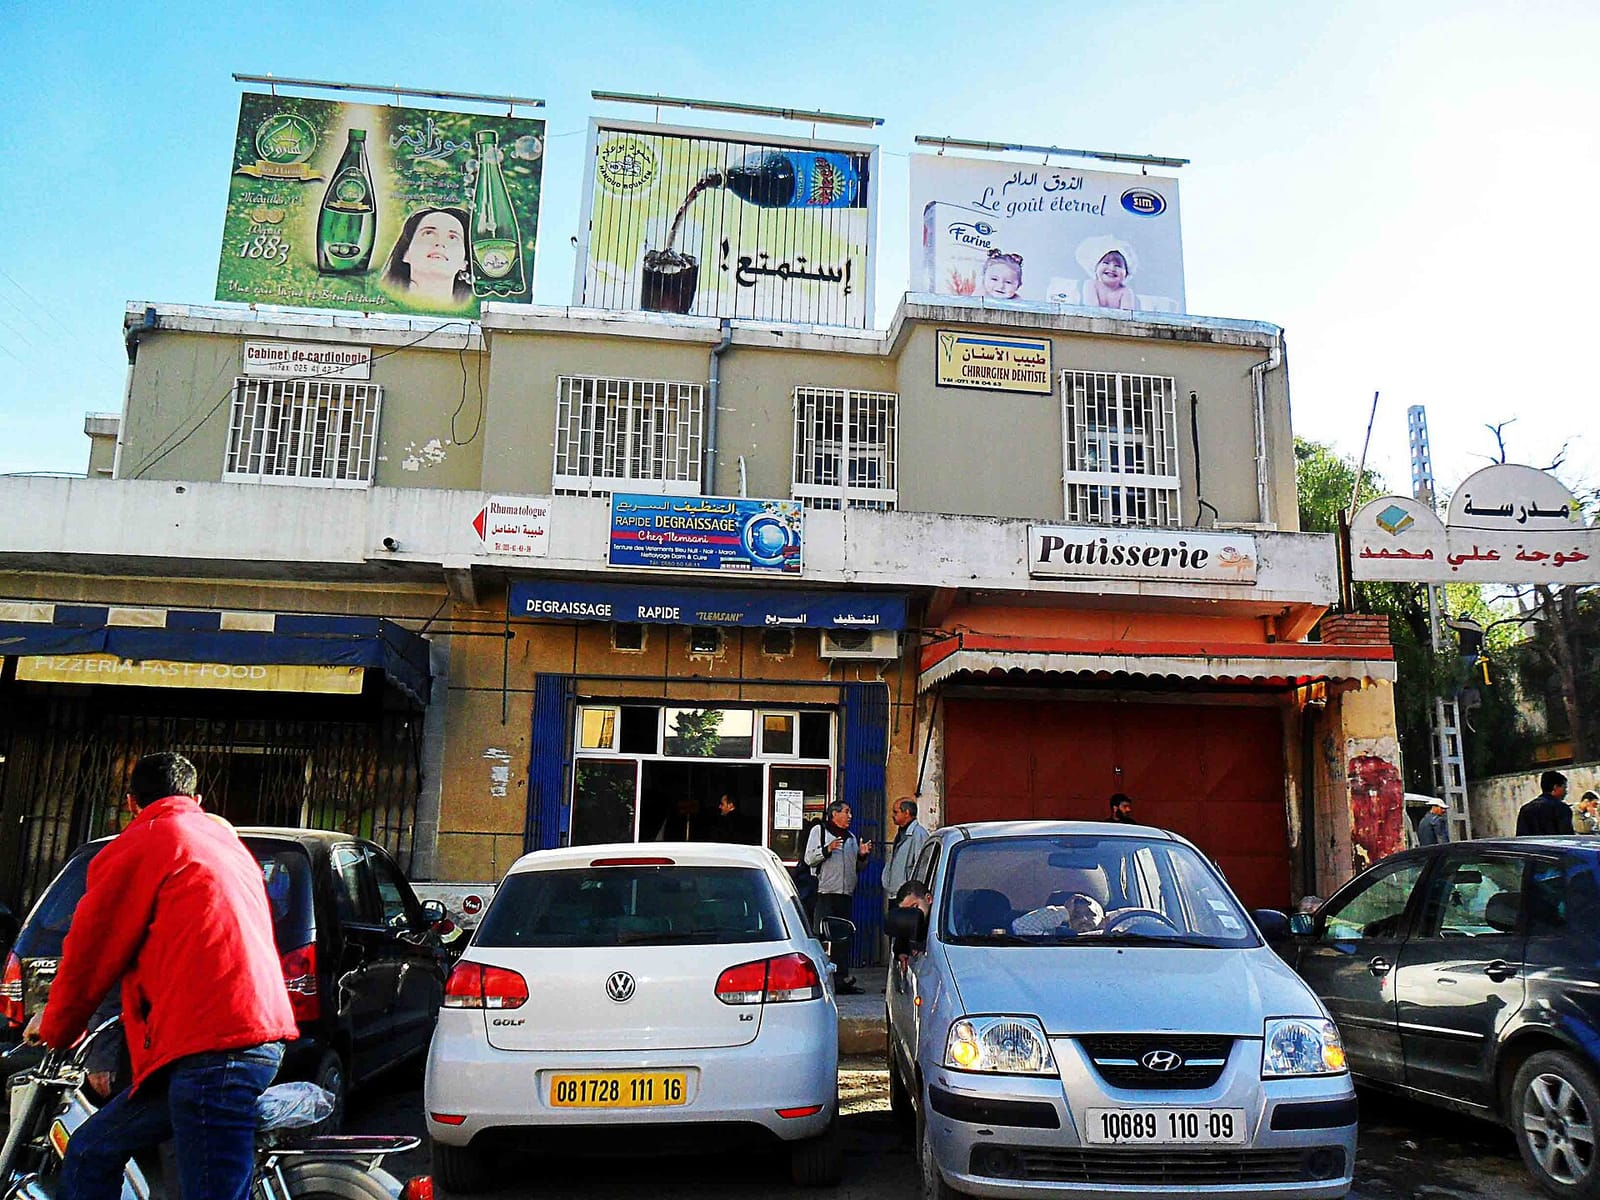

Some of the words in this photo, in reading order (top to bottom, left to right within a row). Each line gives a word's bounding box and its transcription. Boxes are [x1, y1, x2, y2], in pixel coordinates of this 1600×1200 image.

[600, 165, 622, 188] HAMOUD
[623, 170, 653, 190] BOUALEM
[1043, 174, 1084, 192] الذوق
[972, 187, 1000, 212] Le
[1006, 197, 1043, 218] goût
[1050, 195, 1107, 217] éternel
[949, 227, 991, 248] Farine
[239, 235, 291, 266] 1883
[248, 347, 288, 361] Cabinet
[292, 350, 305, 361] de
[308, 351, 368, 365] cardiologie
[962, 347, 1009, 362] الأسنان
[1014, 353, 1046, 367] طبيب
[962, 365, 1010, 380] CHIRURGIEN
[1011, 369, 1046, 384] DENTISTE
[490, 502, 547, 519] Rhumatologue
[616, 501, 670, 512] السريع
[673, 500, 736, 517] التنظيف
[1464, 494, 1569, 524] مدرسة
[522, 524, 544, 538] طبيبة
[615, 516, 651, 527] RAPIDE
[655, 516, 735, 531] DEGRAISSAGE
[638, 530, 663, 544] Chez
[664, 532, 709, 543] Tlemsani
[641, 552, 671, 560] Nettoyage
[1037, 535, 1209, 569] Patisserie
[1359, 545, 1434, 560] محمد
[1446, 545, 1500, 571] علي
[1515, 544, 1590, 568] خوجة
[526, 599, 612, 616] DEGRAISSAGE
[637, 606, 680, 619] RAPIDE
[765, 613, 807, 626] السريع
[833, 613, 880, 627] التنظيف
[34, 656, 134, 674] PIZZERIA
[140, 660, 267, 679] FAST-FOOD
[493, 1018, 525, 1026] GOLF
[557, 1080, 619, 1102] 081728
[631, 1079, 652, 1101] 111
[663, 1078, 680, 1100] 16
[1168, 1113, 1198, 1139] 110
[1209, 1113, 1233, 1139] 09
